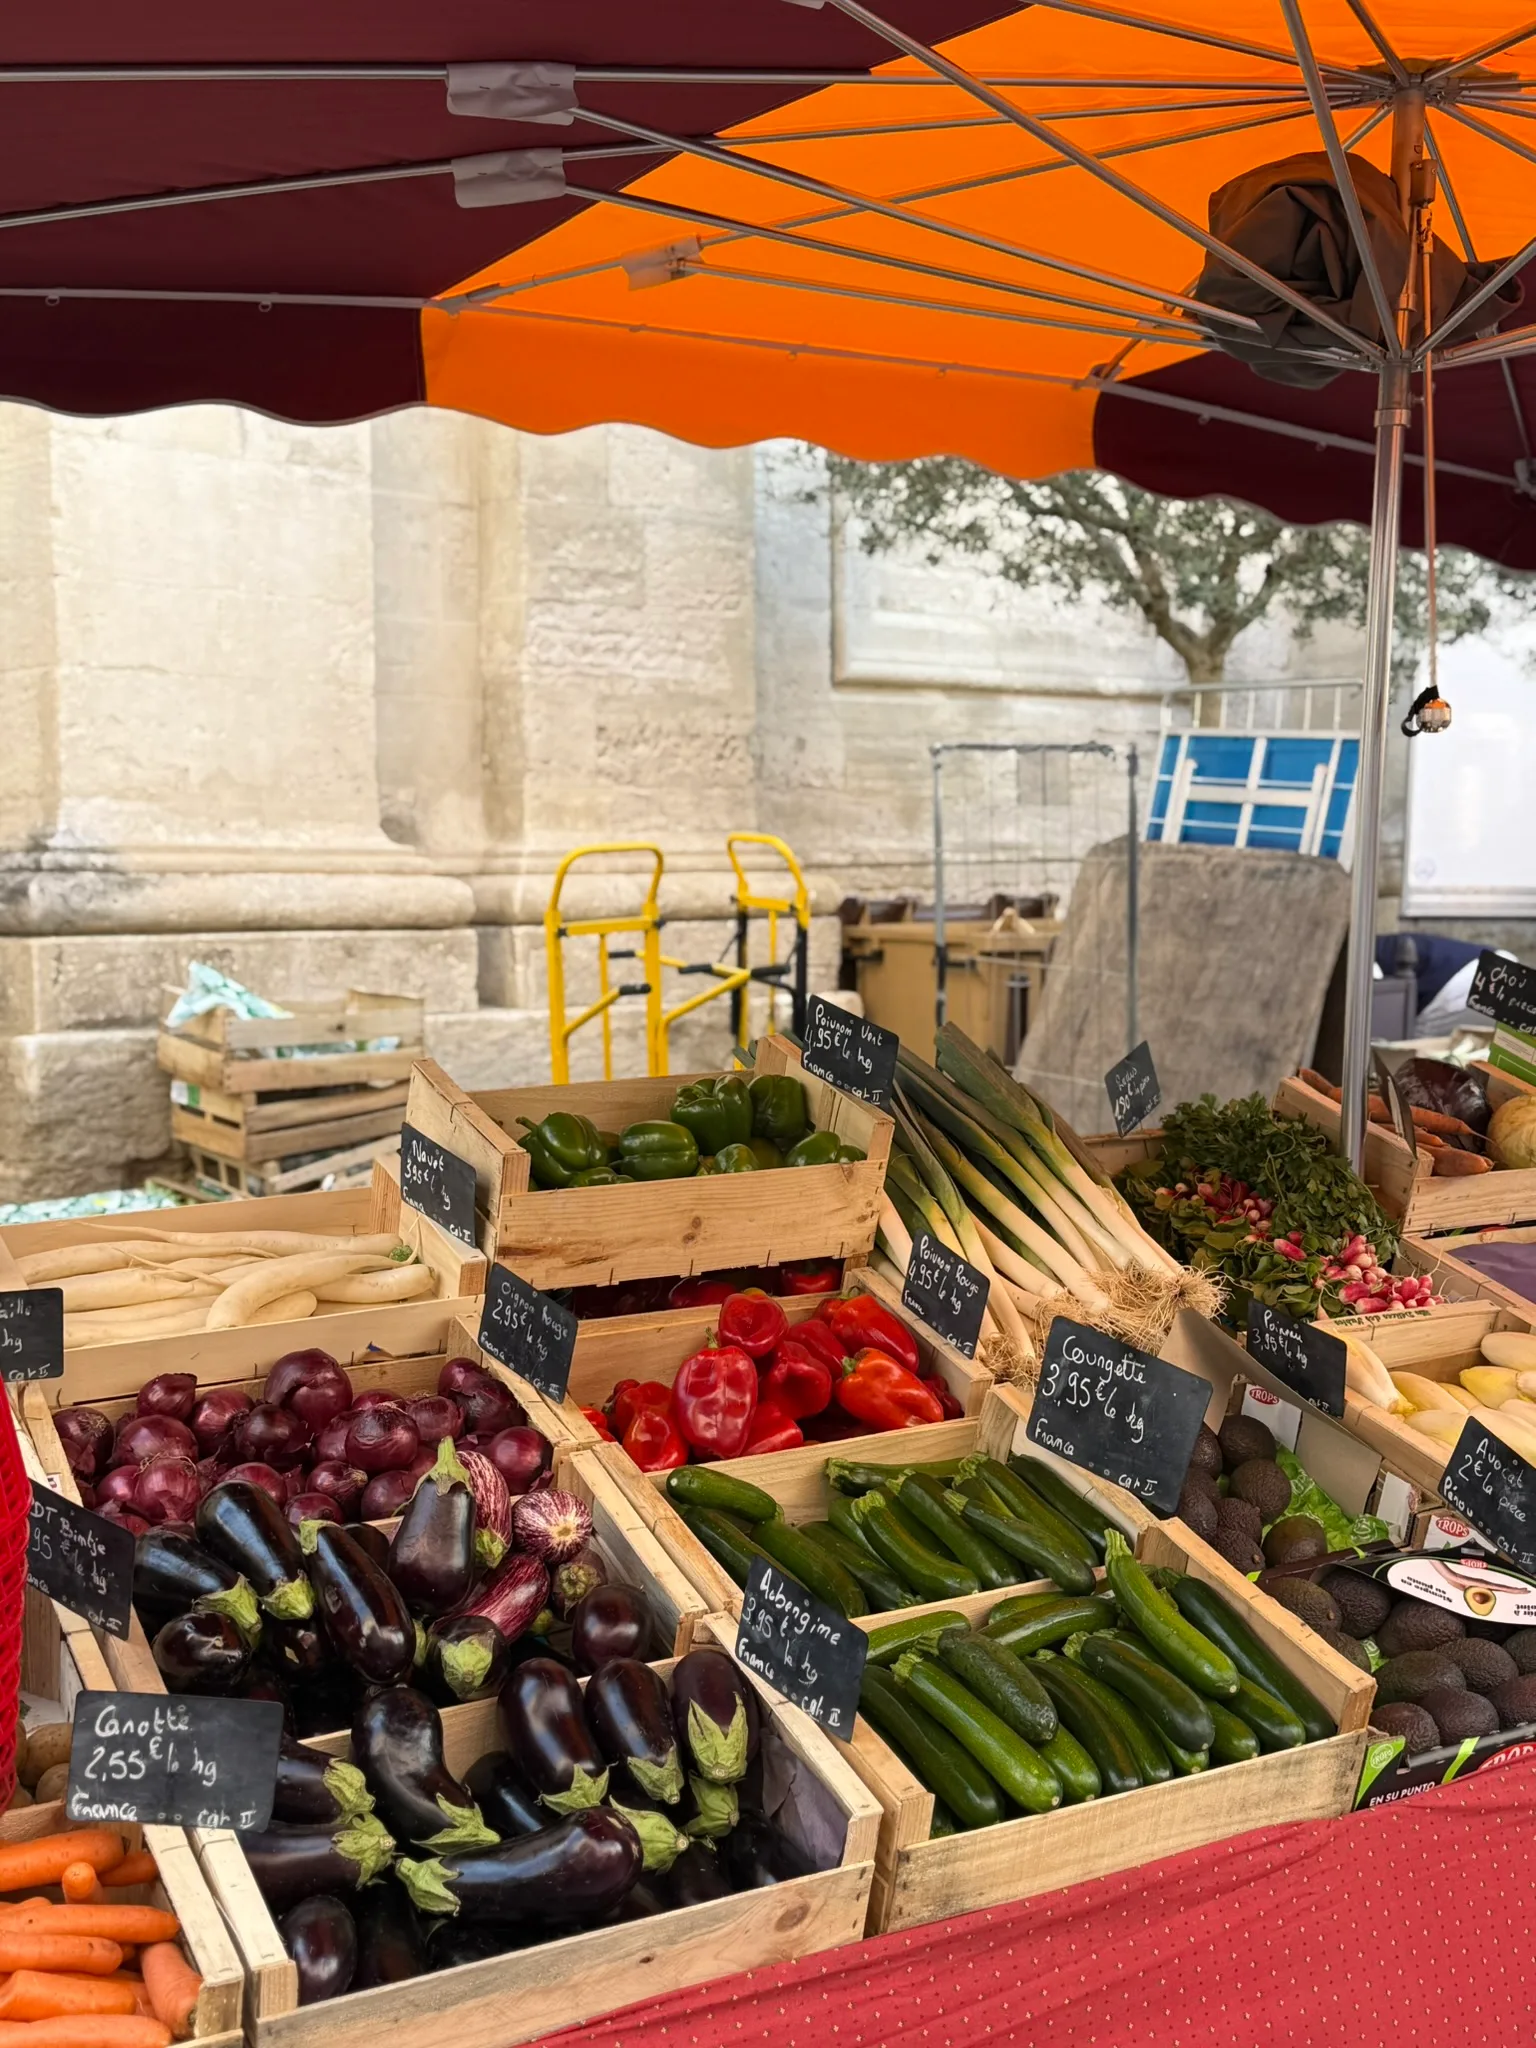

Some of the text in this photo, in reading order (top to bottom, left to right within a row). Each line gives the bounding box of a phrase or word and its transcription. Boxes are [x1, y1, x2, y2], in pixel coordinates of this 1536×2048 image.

[857, 1047, 872, 1074] kg
[1250, 1389, 1279, 1404] TROPS
[1034, 1418, 1075, 1456] France
[1125, 1401, 1144, 1444] kg
[1475, 1437, 1524, 1489] Avocat
[1443, 1475, 1474, 1518] Pérou
[1482, 1471, 1493, 1496] la
[30, 1498, 106, 1556] DT Bintje
[1436, 1519, 1469, 1537] TROPS
[94, 1704, 190, 1738] Carotte
[190, 1744, 217, 1787] kg
[71, 1792, 138, 1821] France
[1369, 1781, 1436, 1807] EN SU PUNTO
